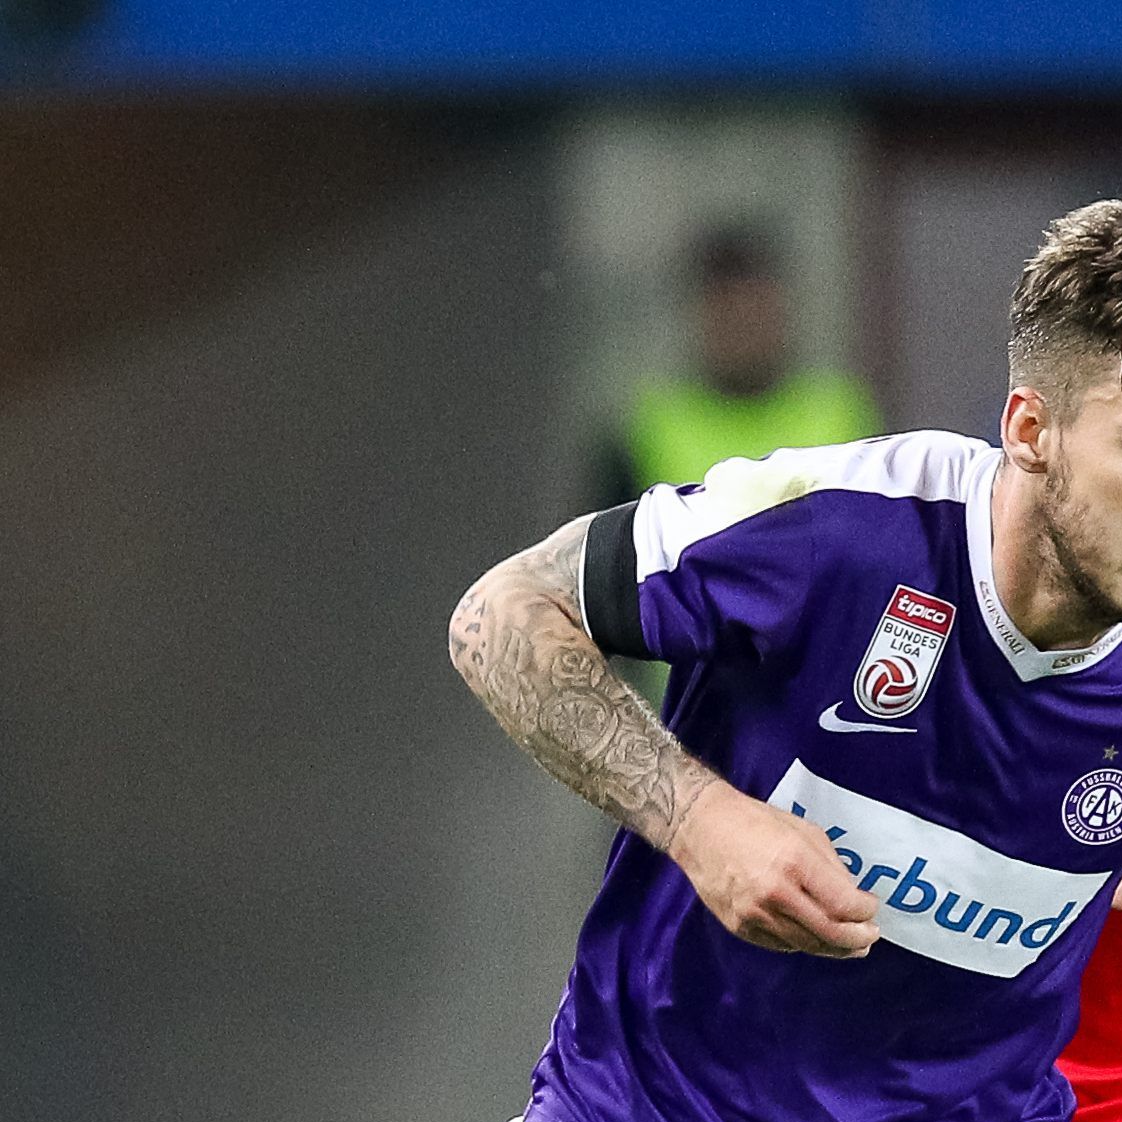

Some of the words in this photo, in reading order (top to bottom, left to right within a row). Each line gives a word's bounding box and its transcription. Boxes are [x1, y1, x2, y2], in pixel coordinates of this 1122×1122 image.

[897, 594, 948, 624] tipico
[883, 622, 938, 650] BUNDES
[890, 638, 921, 658] LIGA
